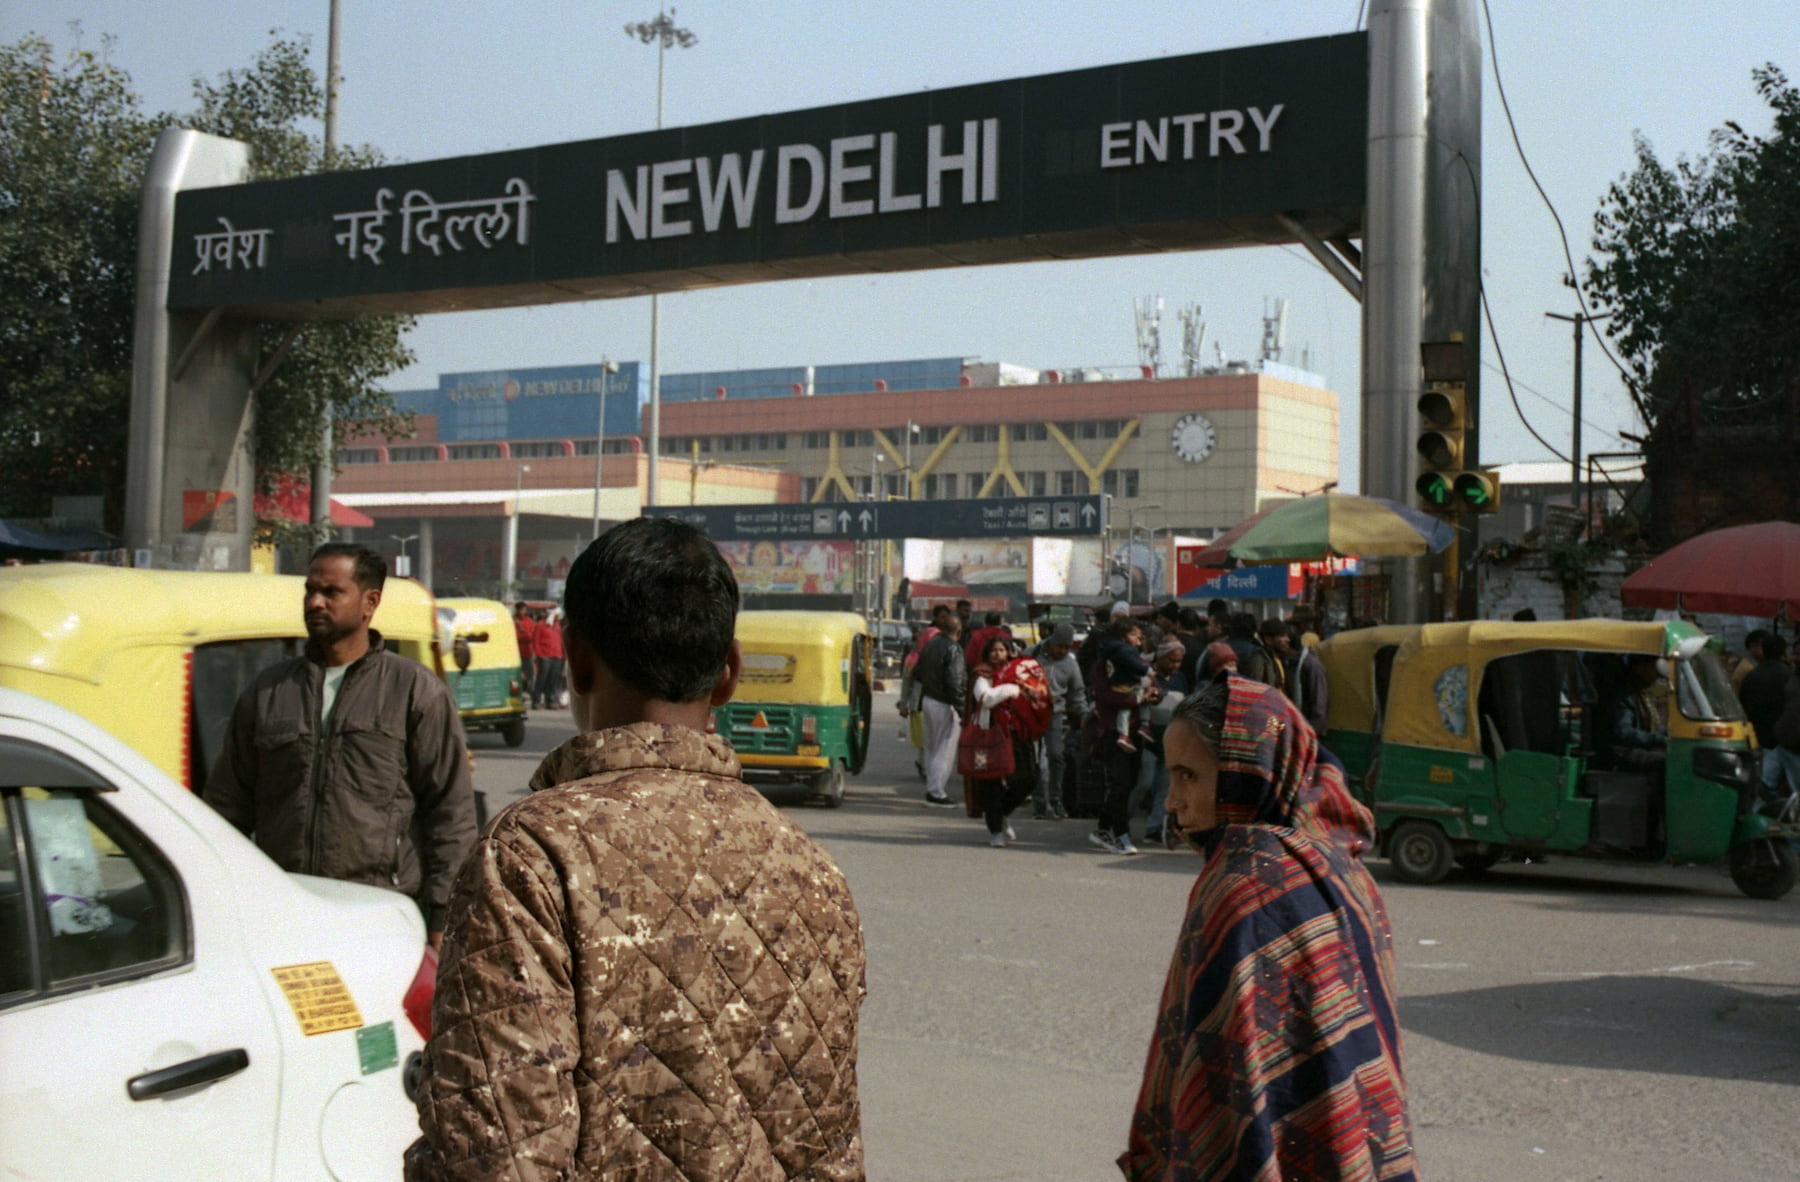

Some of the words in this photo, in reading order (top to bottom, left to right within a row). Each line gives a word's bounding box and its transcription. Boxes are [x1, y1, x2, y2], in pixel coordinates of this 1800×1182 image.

[1100, 103, 1285, 169] ENTRY
[605, 148, 766, 244] NEW
[775, 117, 999, 225] DELHI
[192, 216, 275, 276] प्रवेश
[333, 187, 396, 265] नई
[399, 177, 537, 256] दिल्ली
[1227, 573, 1257, 589] दिल्ली
